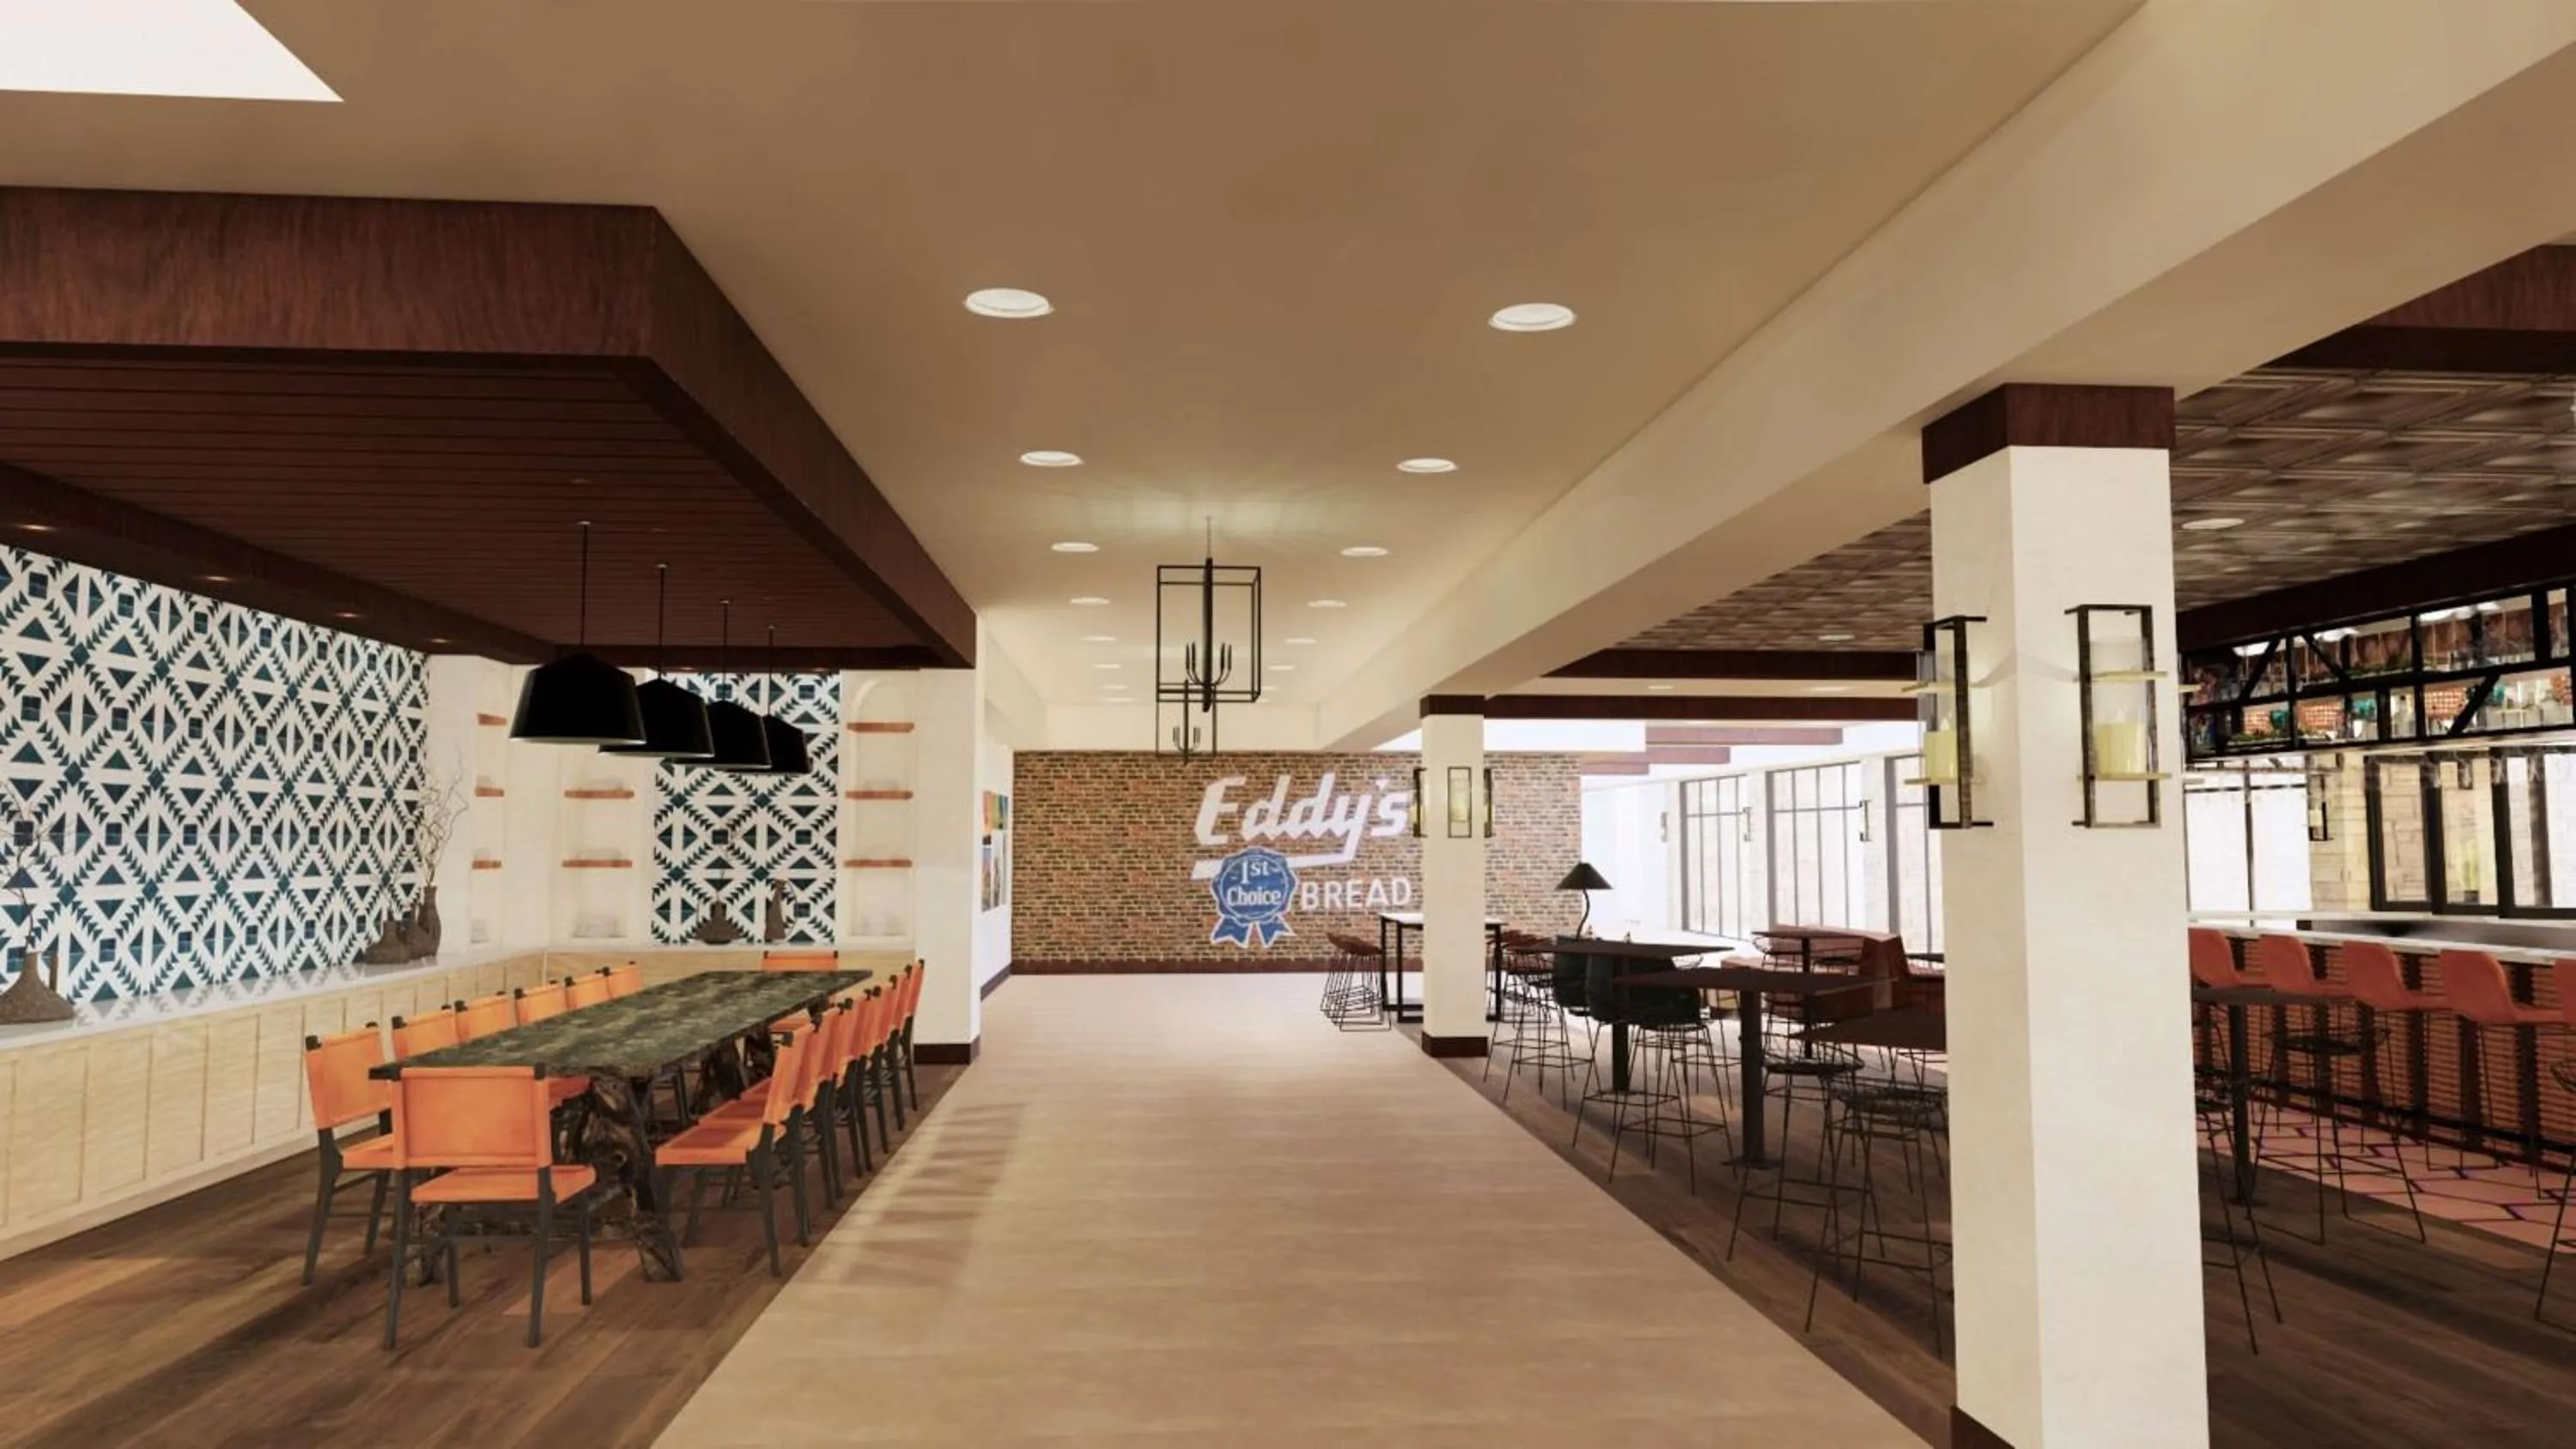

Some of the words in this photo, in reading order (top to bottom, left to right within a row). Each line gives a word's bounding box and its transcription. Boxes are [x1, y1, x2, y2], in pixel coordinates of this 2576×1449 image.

[1194, 773, 1409, 867] Eddy's
[1240, 860, 1271, 883] 1st
[1225, 886, 1282, 907] Choice
[1300, 877, 1412, 911] BREAD
